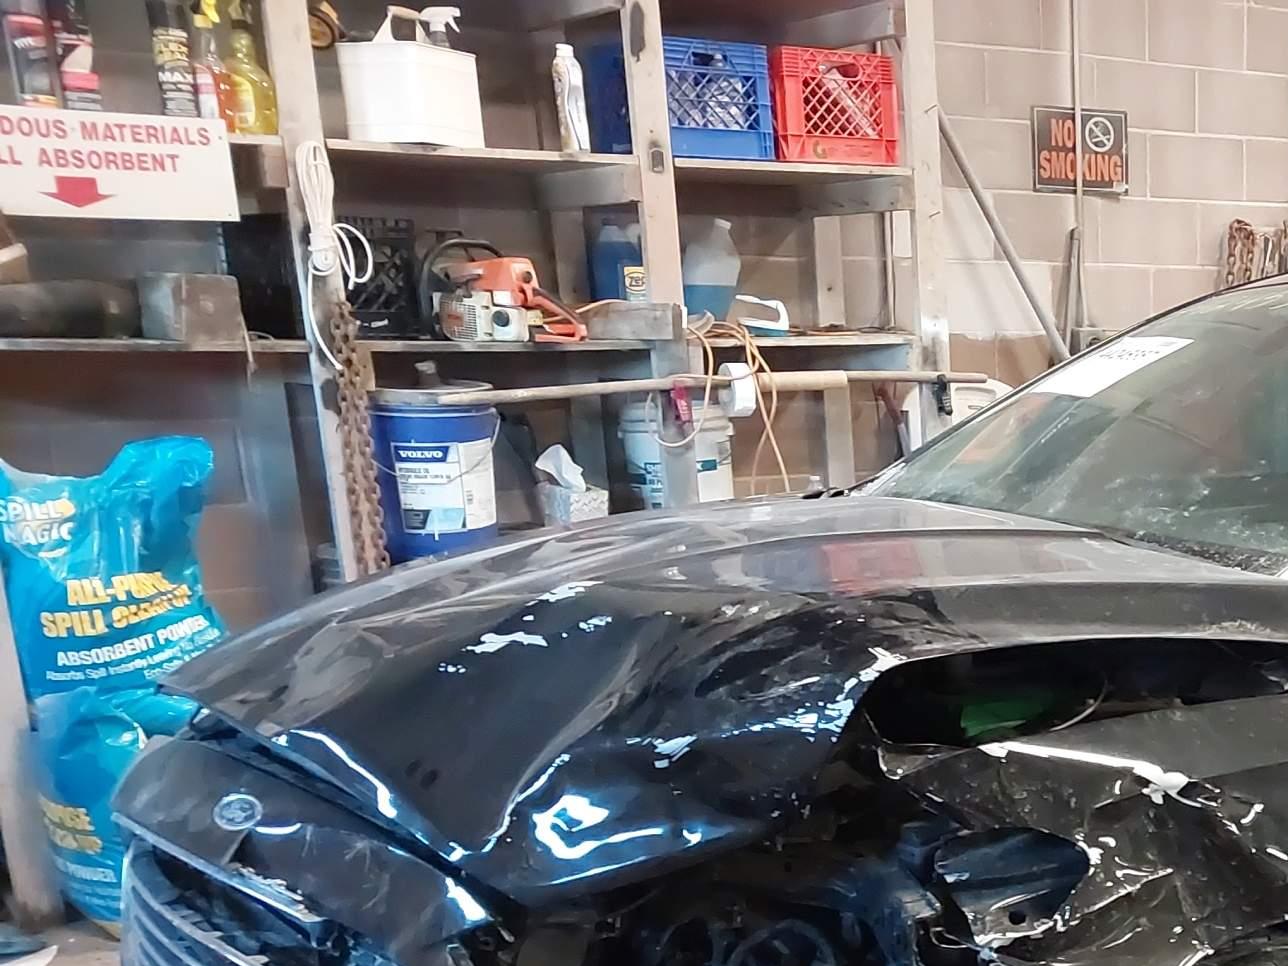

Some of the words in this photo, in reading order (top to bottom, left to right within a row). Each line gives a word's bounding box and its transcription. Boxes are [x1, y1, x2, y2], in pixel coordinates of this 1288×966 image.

[80, 121, 211, 145] MATERIALS
[1051, 118, 1075, 148] NO
[38, 147, 180, 172] ABSORBENT
[397, 450, 443, 459] VOLVO
[40, 609, 108, 638] SPILL
[57, 633, 156, 667] ABSORBENT
